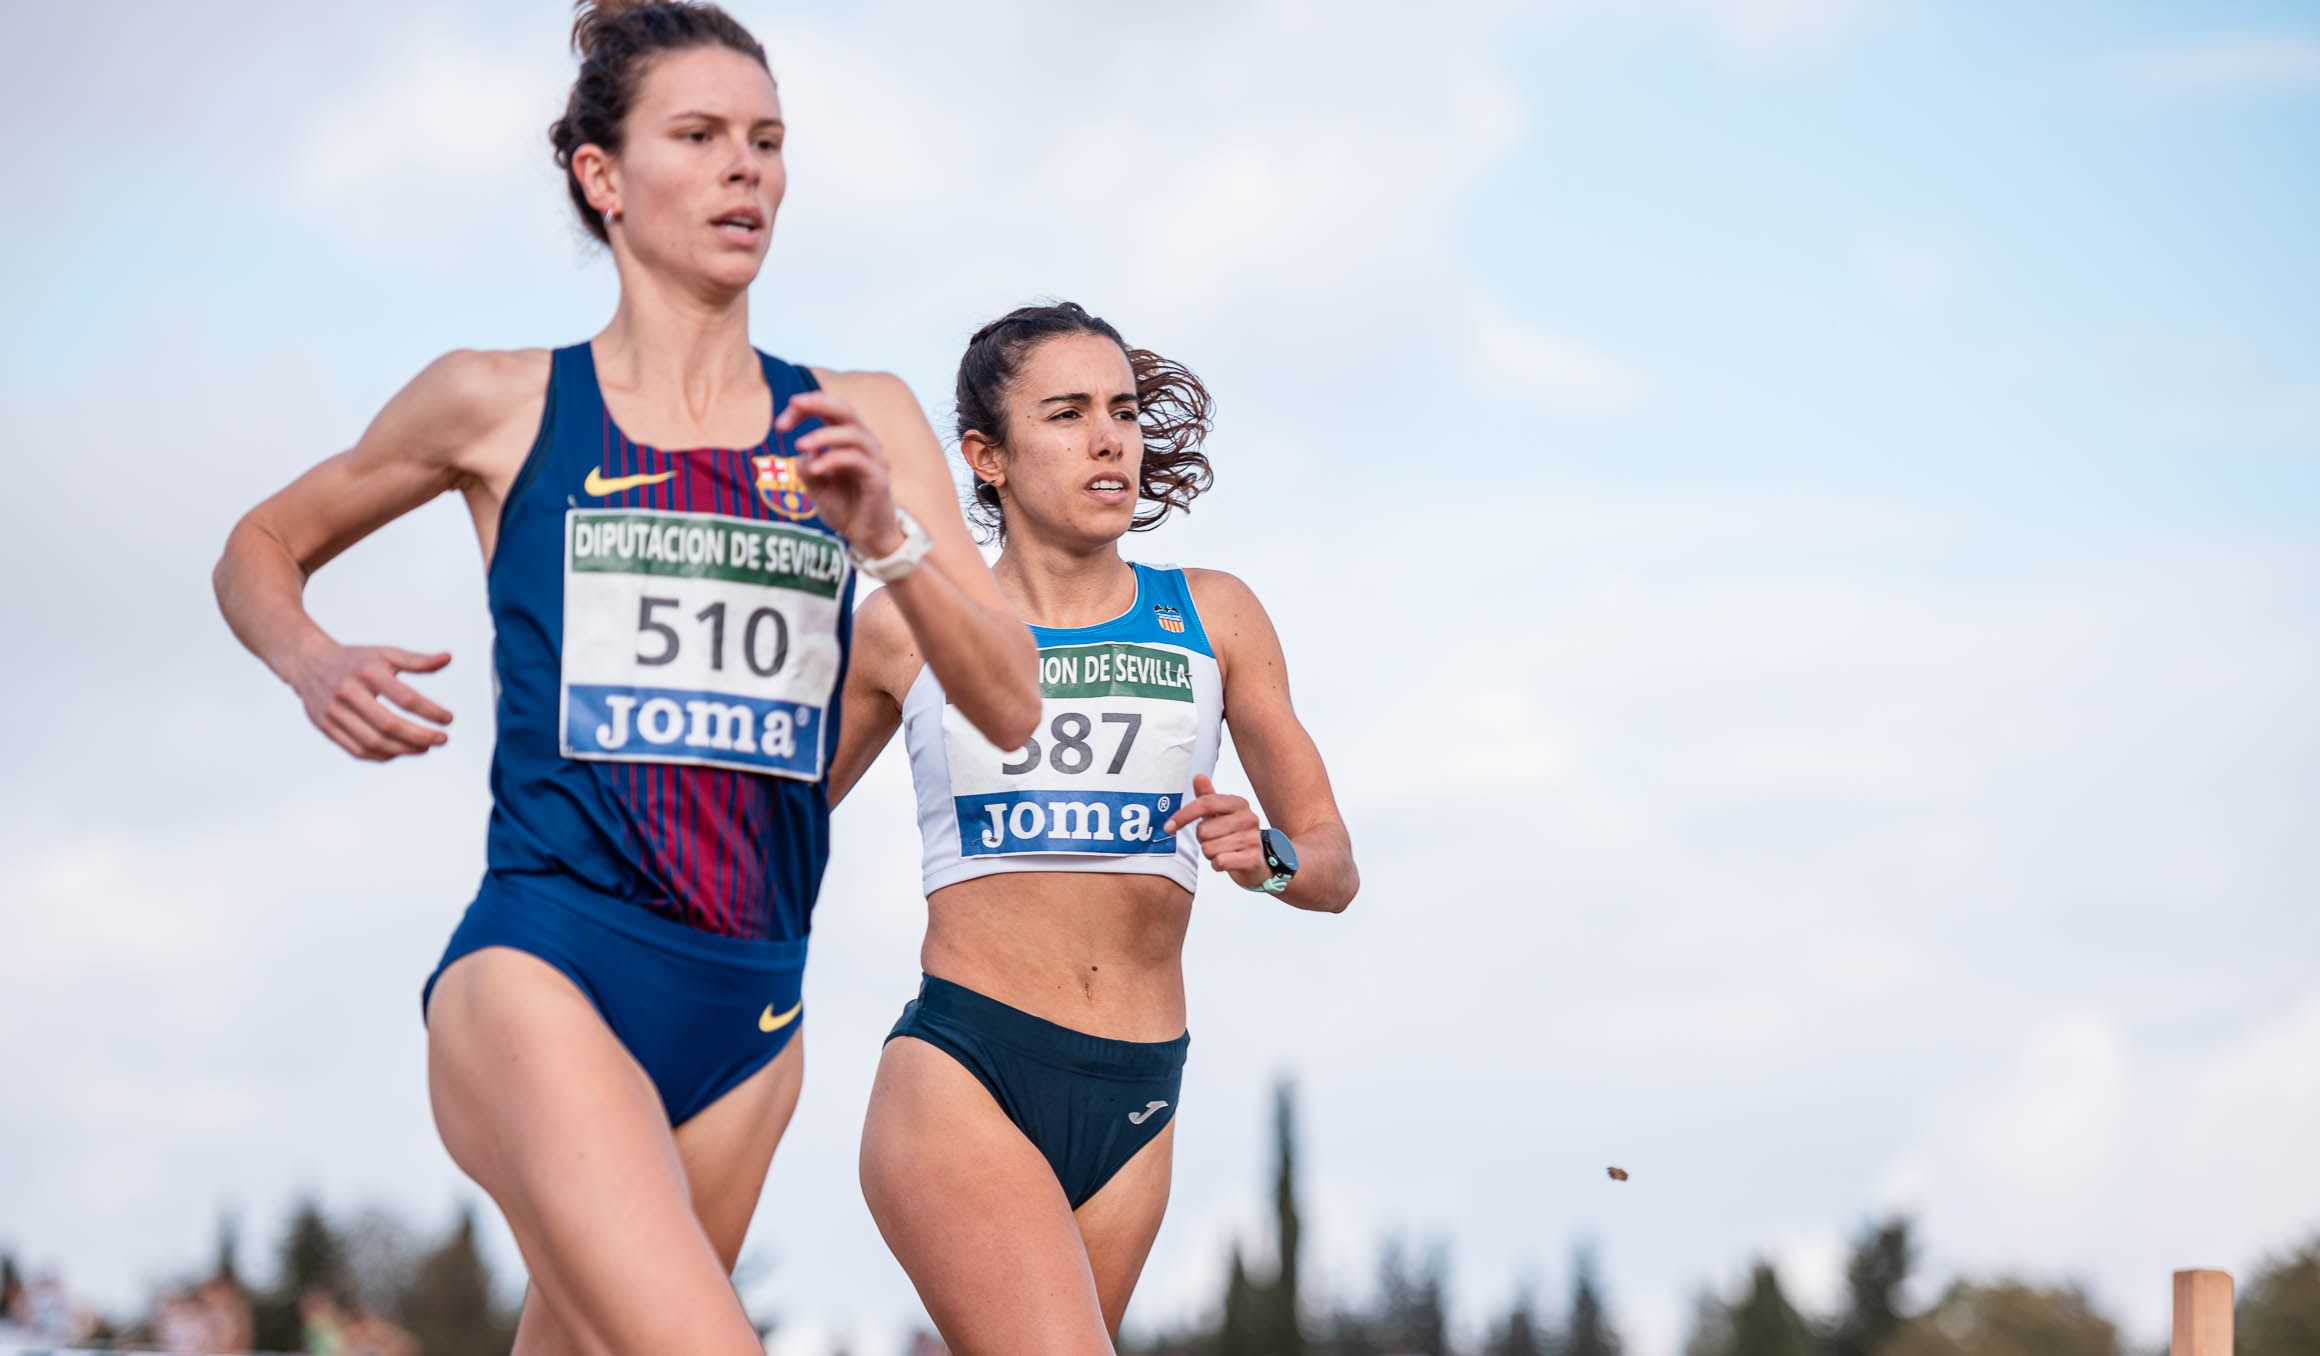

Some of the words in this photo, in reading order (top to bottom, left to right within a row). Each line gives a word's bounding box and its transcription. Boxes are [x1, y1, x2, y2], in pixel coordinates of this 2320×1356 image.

[575, 522, 724, 564] DIPUTACION
[730, 532, 761, 569] DE
[765, 535, 842, 583] SEVILLA
[637, 596, 789, 677] 510
[1084, 654, 1110, 683] DE
[1115, 653, 1191, 689] SEVILLA
